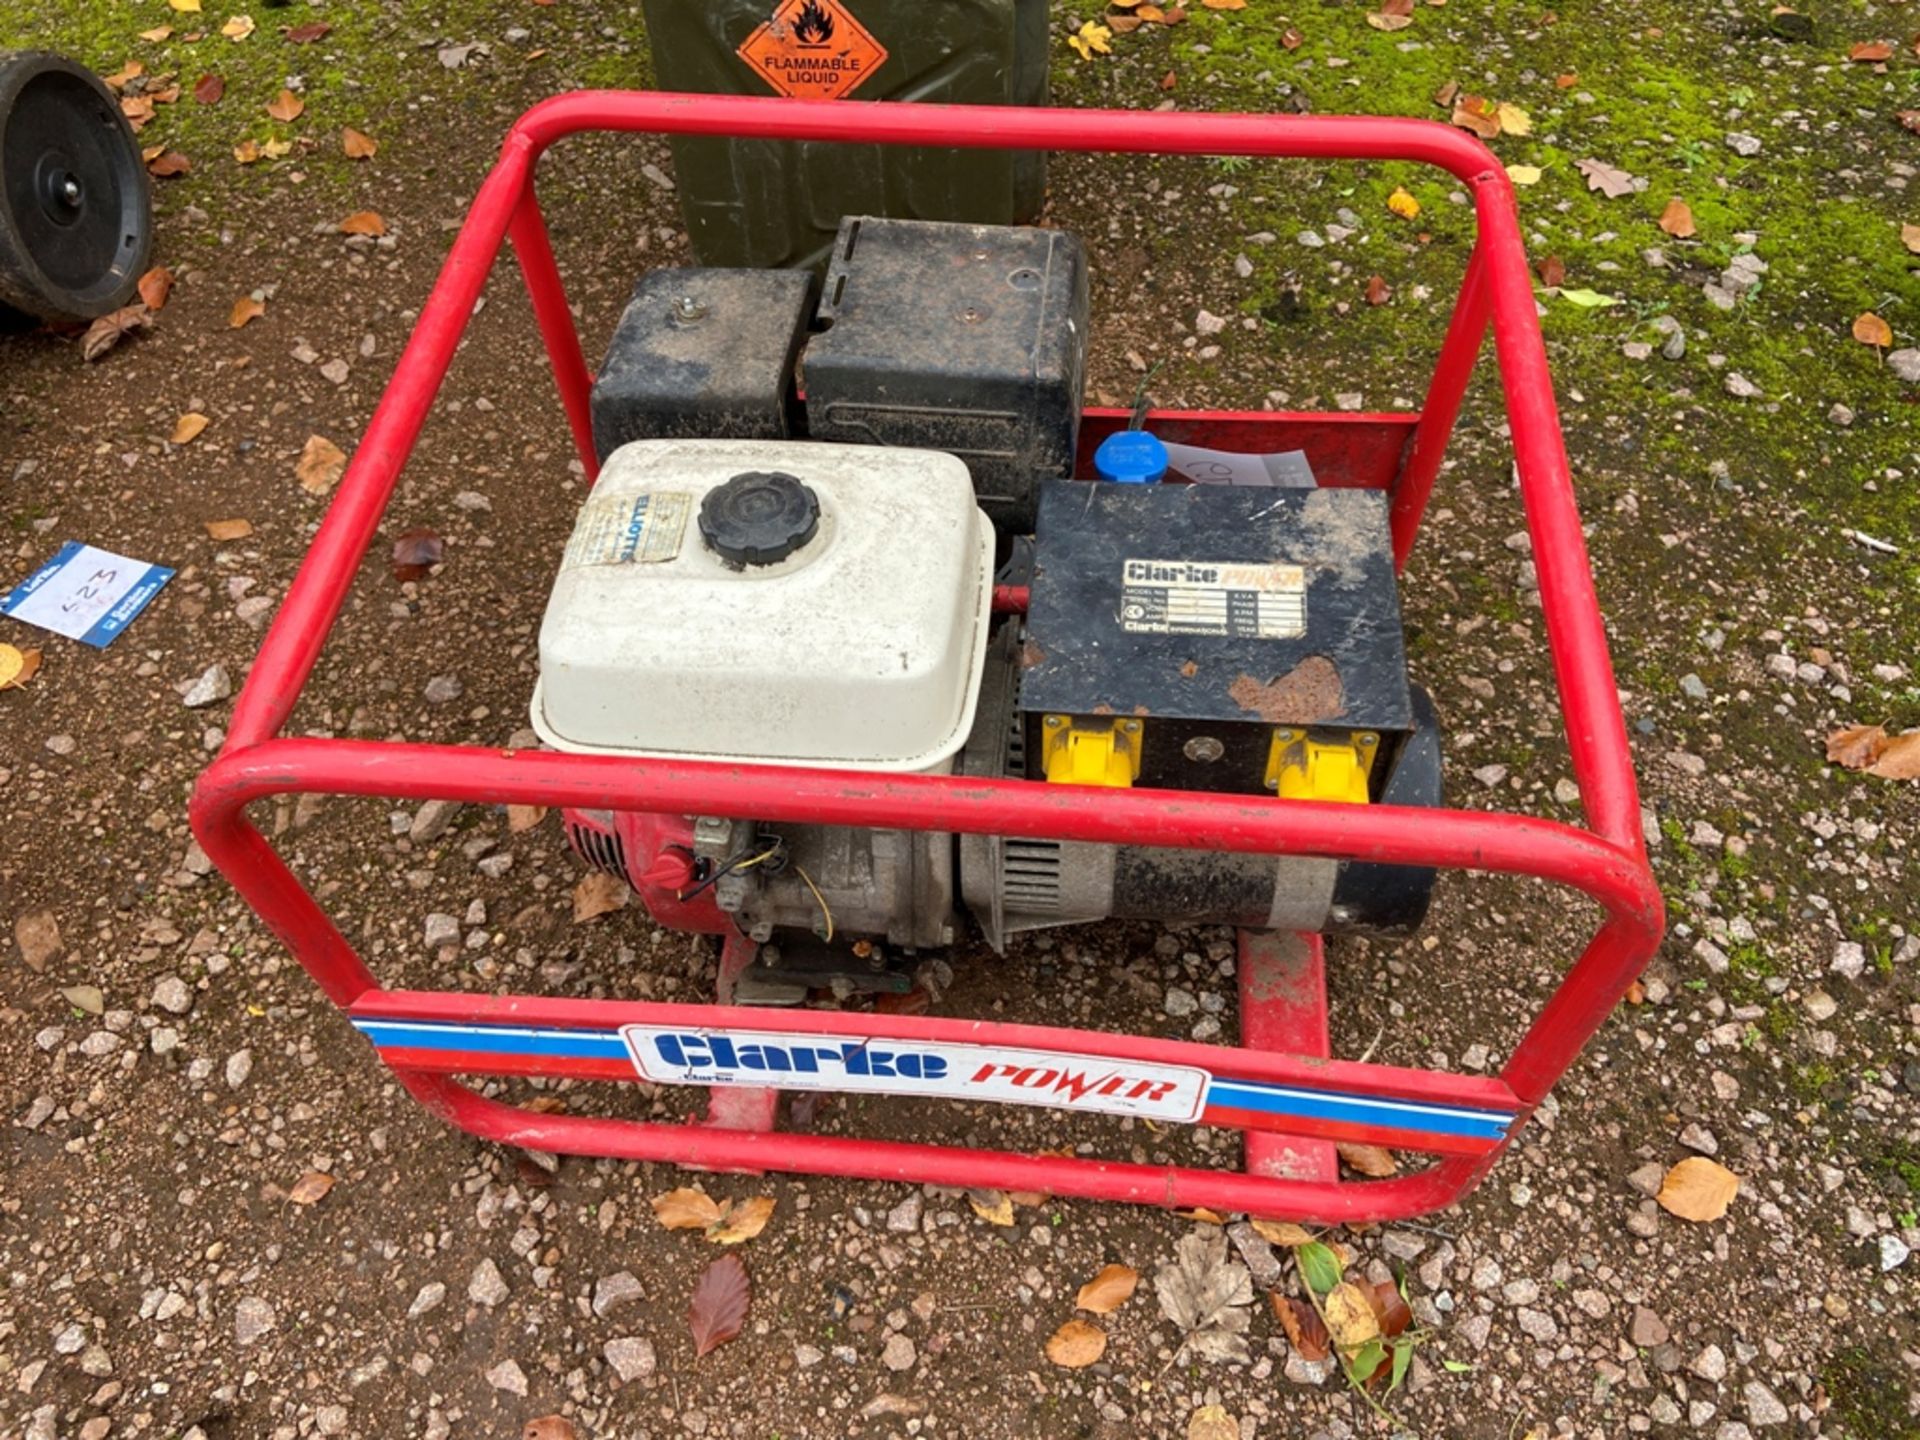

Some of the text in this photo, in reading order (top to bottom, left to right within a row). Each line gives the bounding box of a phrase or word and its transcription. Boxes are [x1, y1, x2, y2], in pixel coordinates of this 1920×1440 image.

[764, 56, 860, 71] FLAMMABLE
[787, 71, 839, 84] LIQUID
[1128, 562, 1218, 584] Clarke
[654, 1034, 1177, 1103] Clarke POWER
